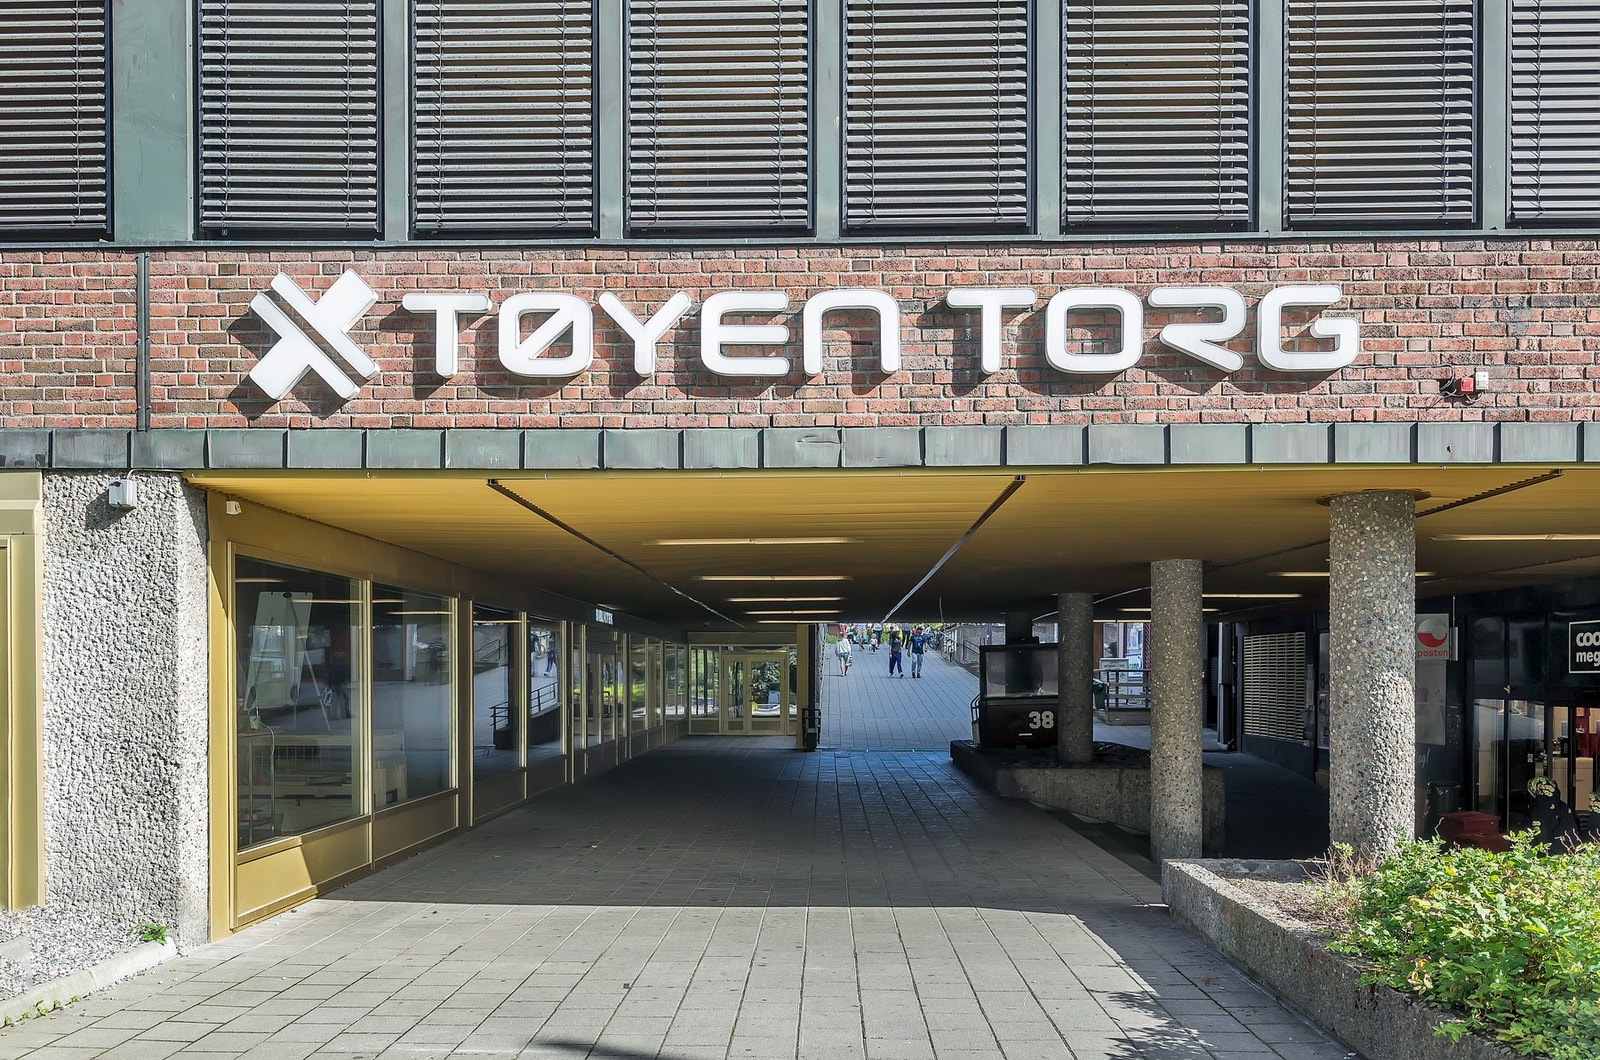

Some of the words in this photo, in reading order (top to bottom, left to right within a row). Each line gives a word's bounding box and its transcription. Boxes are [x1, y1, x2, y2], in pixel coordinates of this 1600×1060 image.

[402, 289, 902, 378] TØYEN
[946, 285, 1361, 375] TORG
[1417, 649, 1448, 658] posten
[1029, 711, 1054, 729] 38
